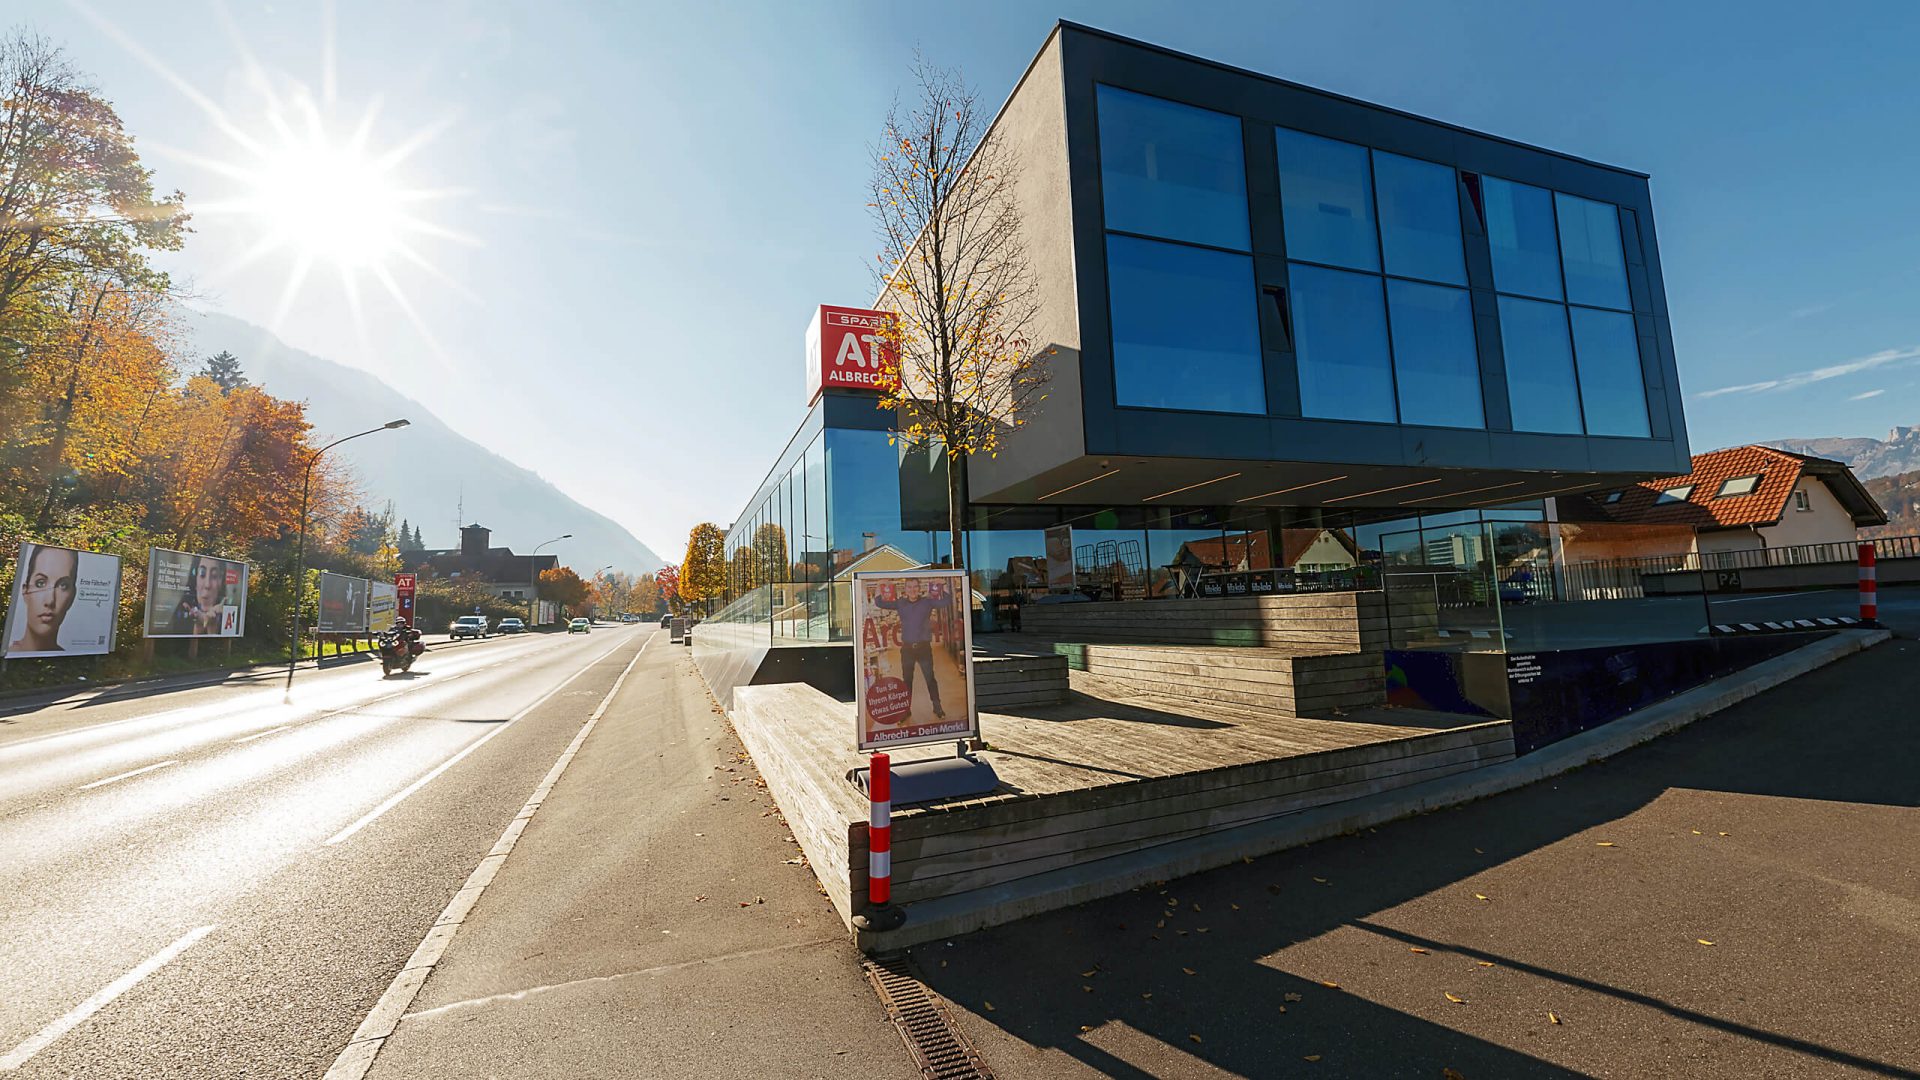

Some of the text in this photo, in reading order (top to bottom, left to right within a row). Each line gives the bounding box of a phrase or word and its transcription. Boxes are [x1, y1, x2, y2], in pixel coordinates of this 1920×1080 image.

[840, 315, 878, 327] SPAR
[835, 332, 887, 369] AT
[829, 370, 895, 383] ALBRECT
[398, 578, 412, 587] AT
[875, 682, 898, 694] Tun Sie
[868, 690, 909, 706] Ihrem Körper
[871, 700, 910, 716] etwas Gutes!
[873, 729, 909, 742] Albrecht
[918, 725, 938, 736] Dein
[940, 722, 966, 733] Markt.
